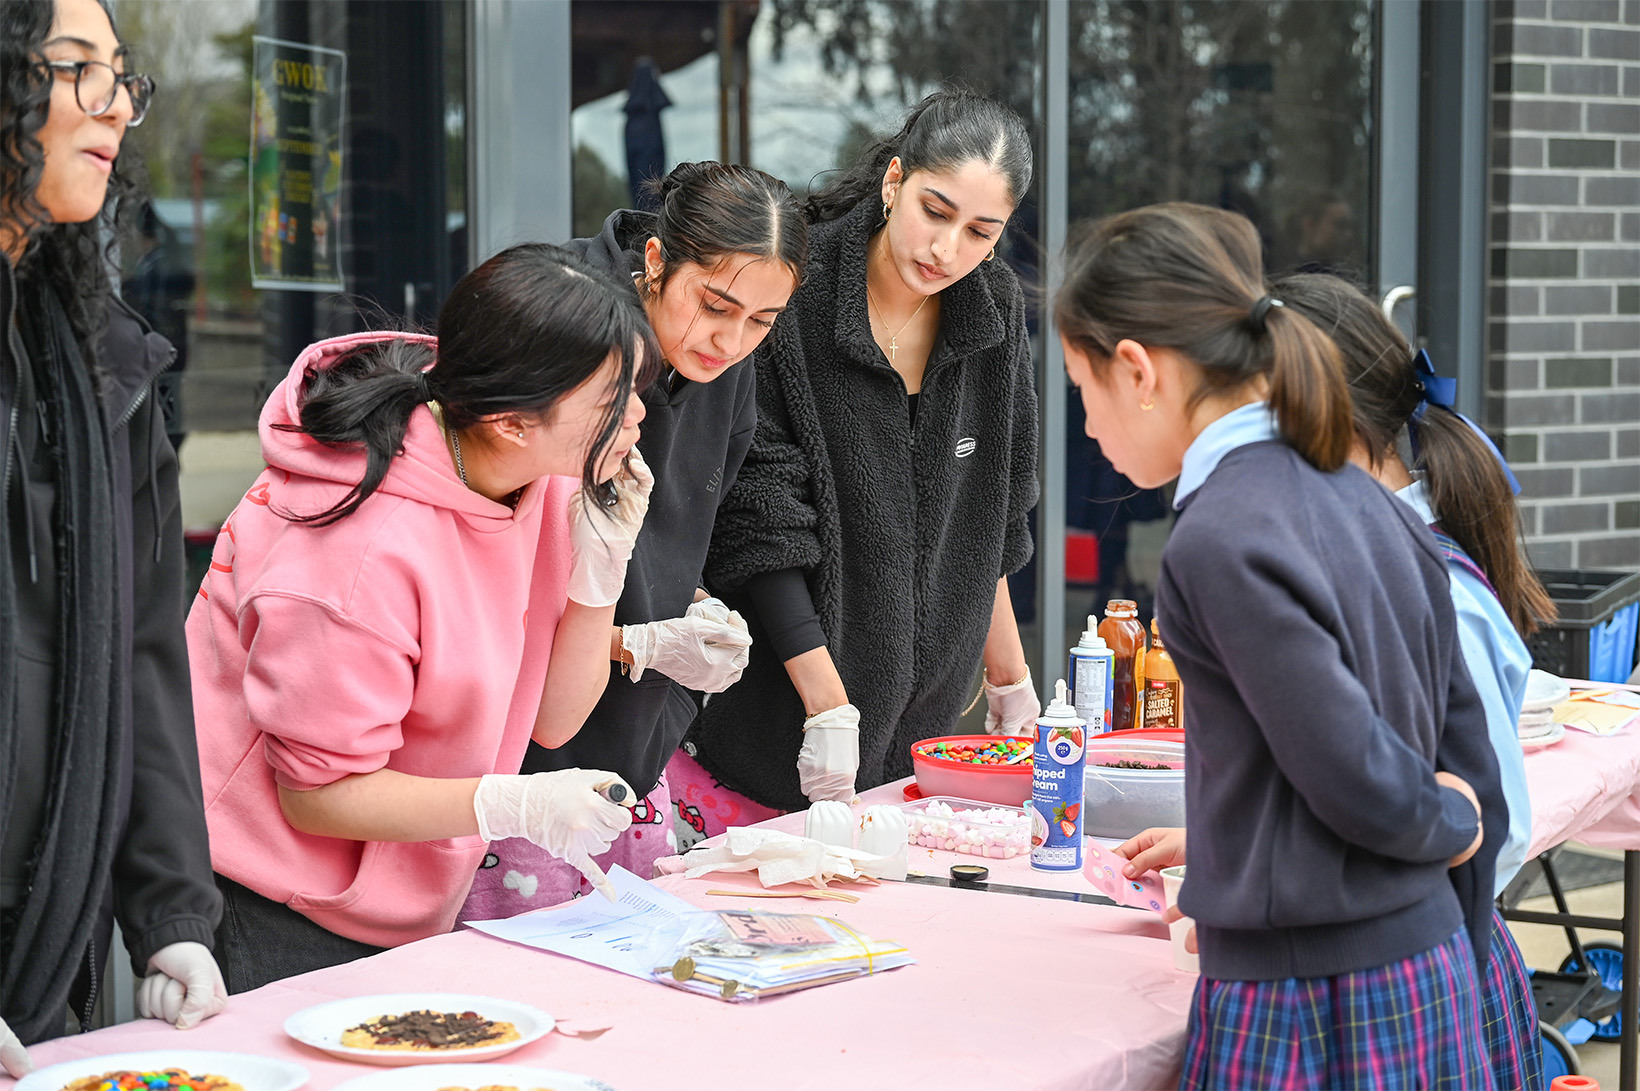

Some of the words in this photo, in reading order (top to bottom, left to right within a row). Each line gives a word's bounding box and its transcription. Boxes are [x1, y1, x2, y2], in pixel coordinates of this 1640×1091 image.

[272, 58, 328, 92] GWOK
[1148, 698, 1170, 710] SALTED
[1146, 707, 1174, 719] CARAMEL
